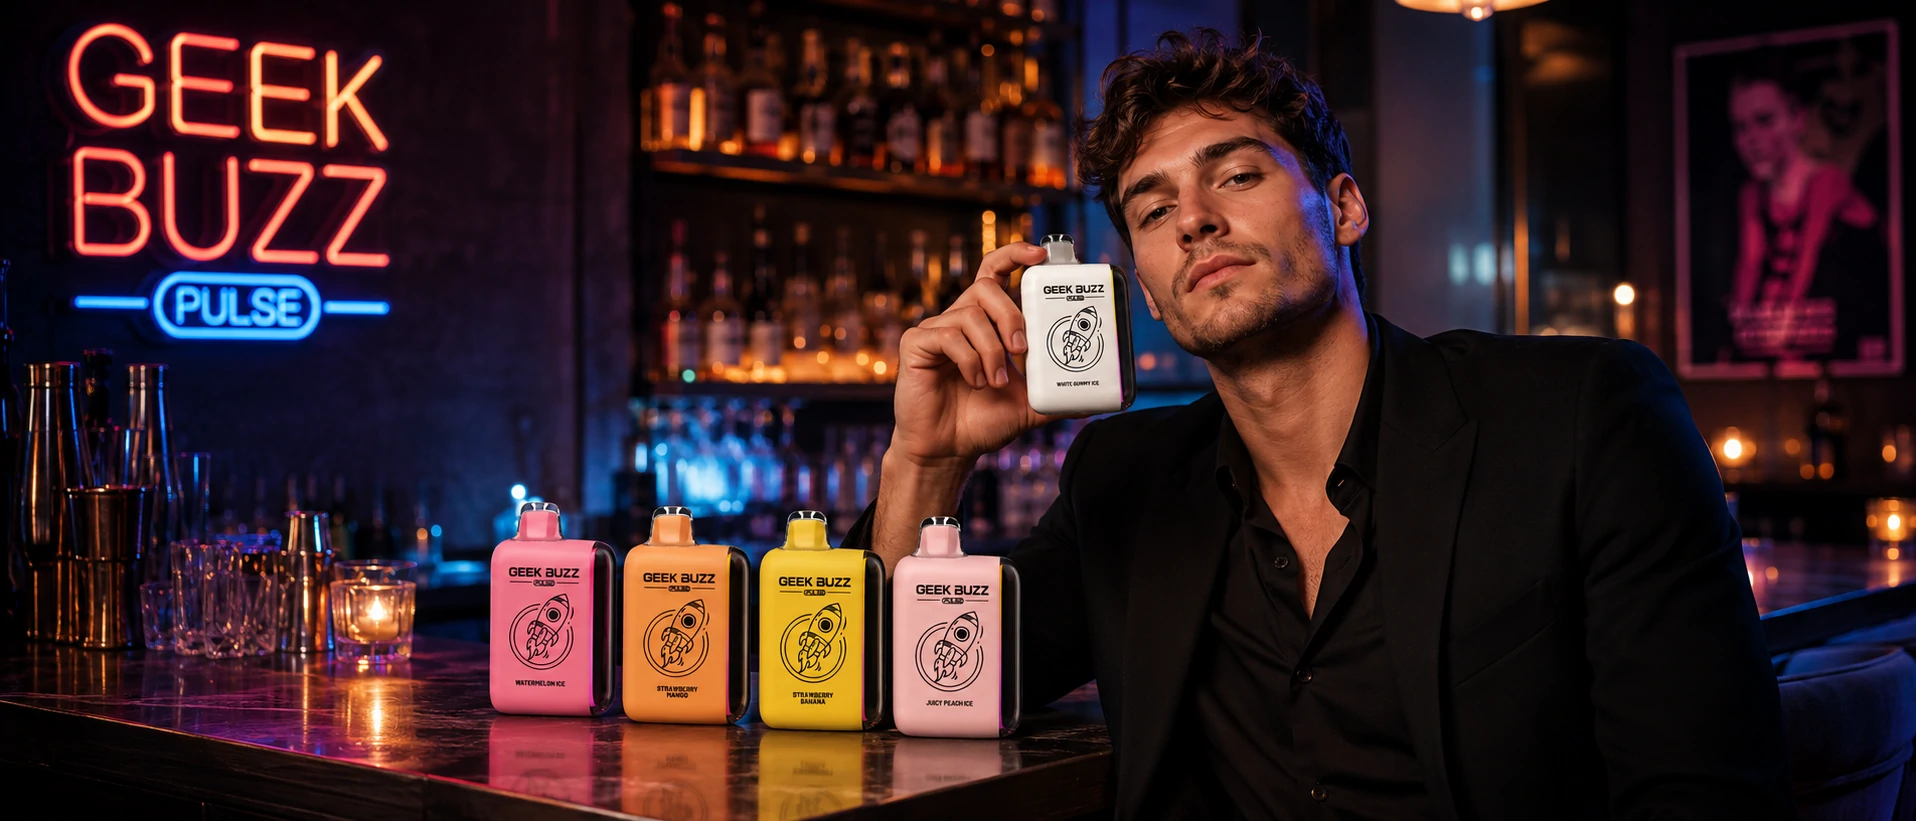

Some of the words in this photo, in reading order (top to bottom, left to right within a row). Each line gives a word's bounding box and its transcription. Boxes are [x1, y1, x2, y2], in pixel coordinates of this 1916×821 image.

[67, 22, 389, 152] GEEK
[73, 146, 390, 267] BUZZ
[1043, 285, 1073, 295] GEEK
[1075, 284, 1105, 294] BUZZ
[174, 285, 304, 328] PULSE
[508, 567, 542, 577] GEEK
[545, 567, 580, 578] BUZZ
[643, 572, 677, 583] GEEK
[681, 573, 716, 584] BUZZ
[778, 576, 813, 587] GEEK
[816, 577, 851, 588] BUZZ
[915, 584, 951, 595] GEEK
[954, 585, 989, 596] BUZZ
[963, 700, 974, 708] ICE
